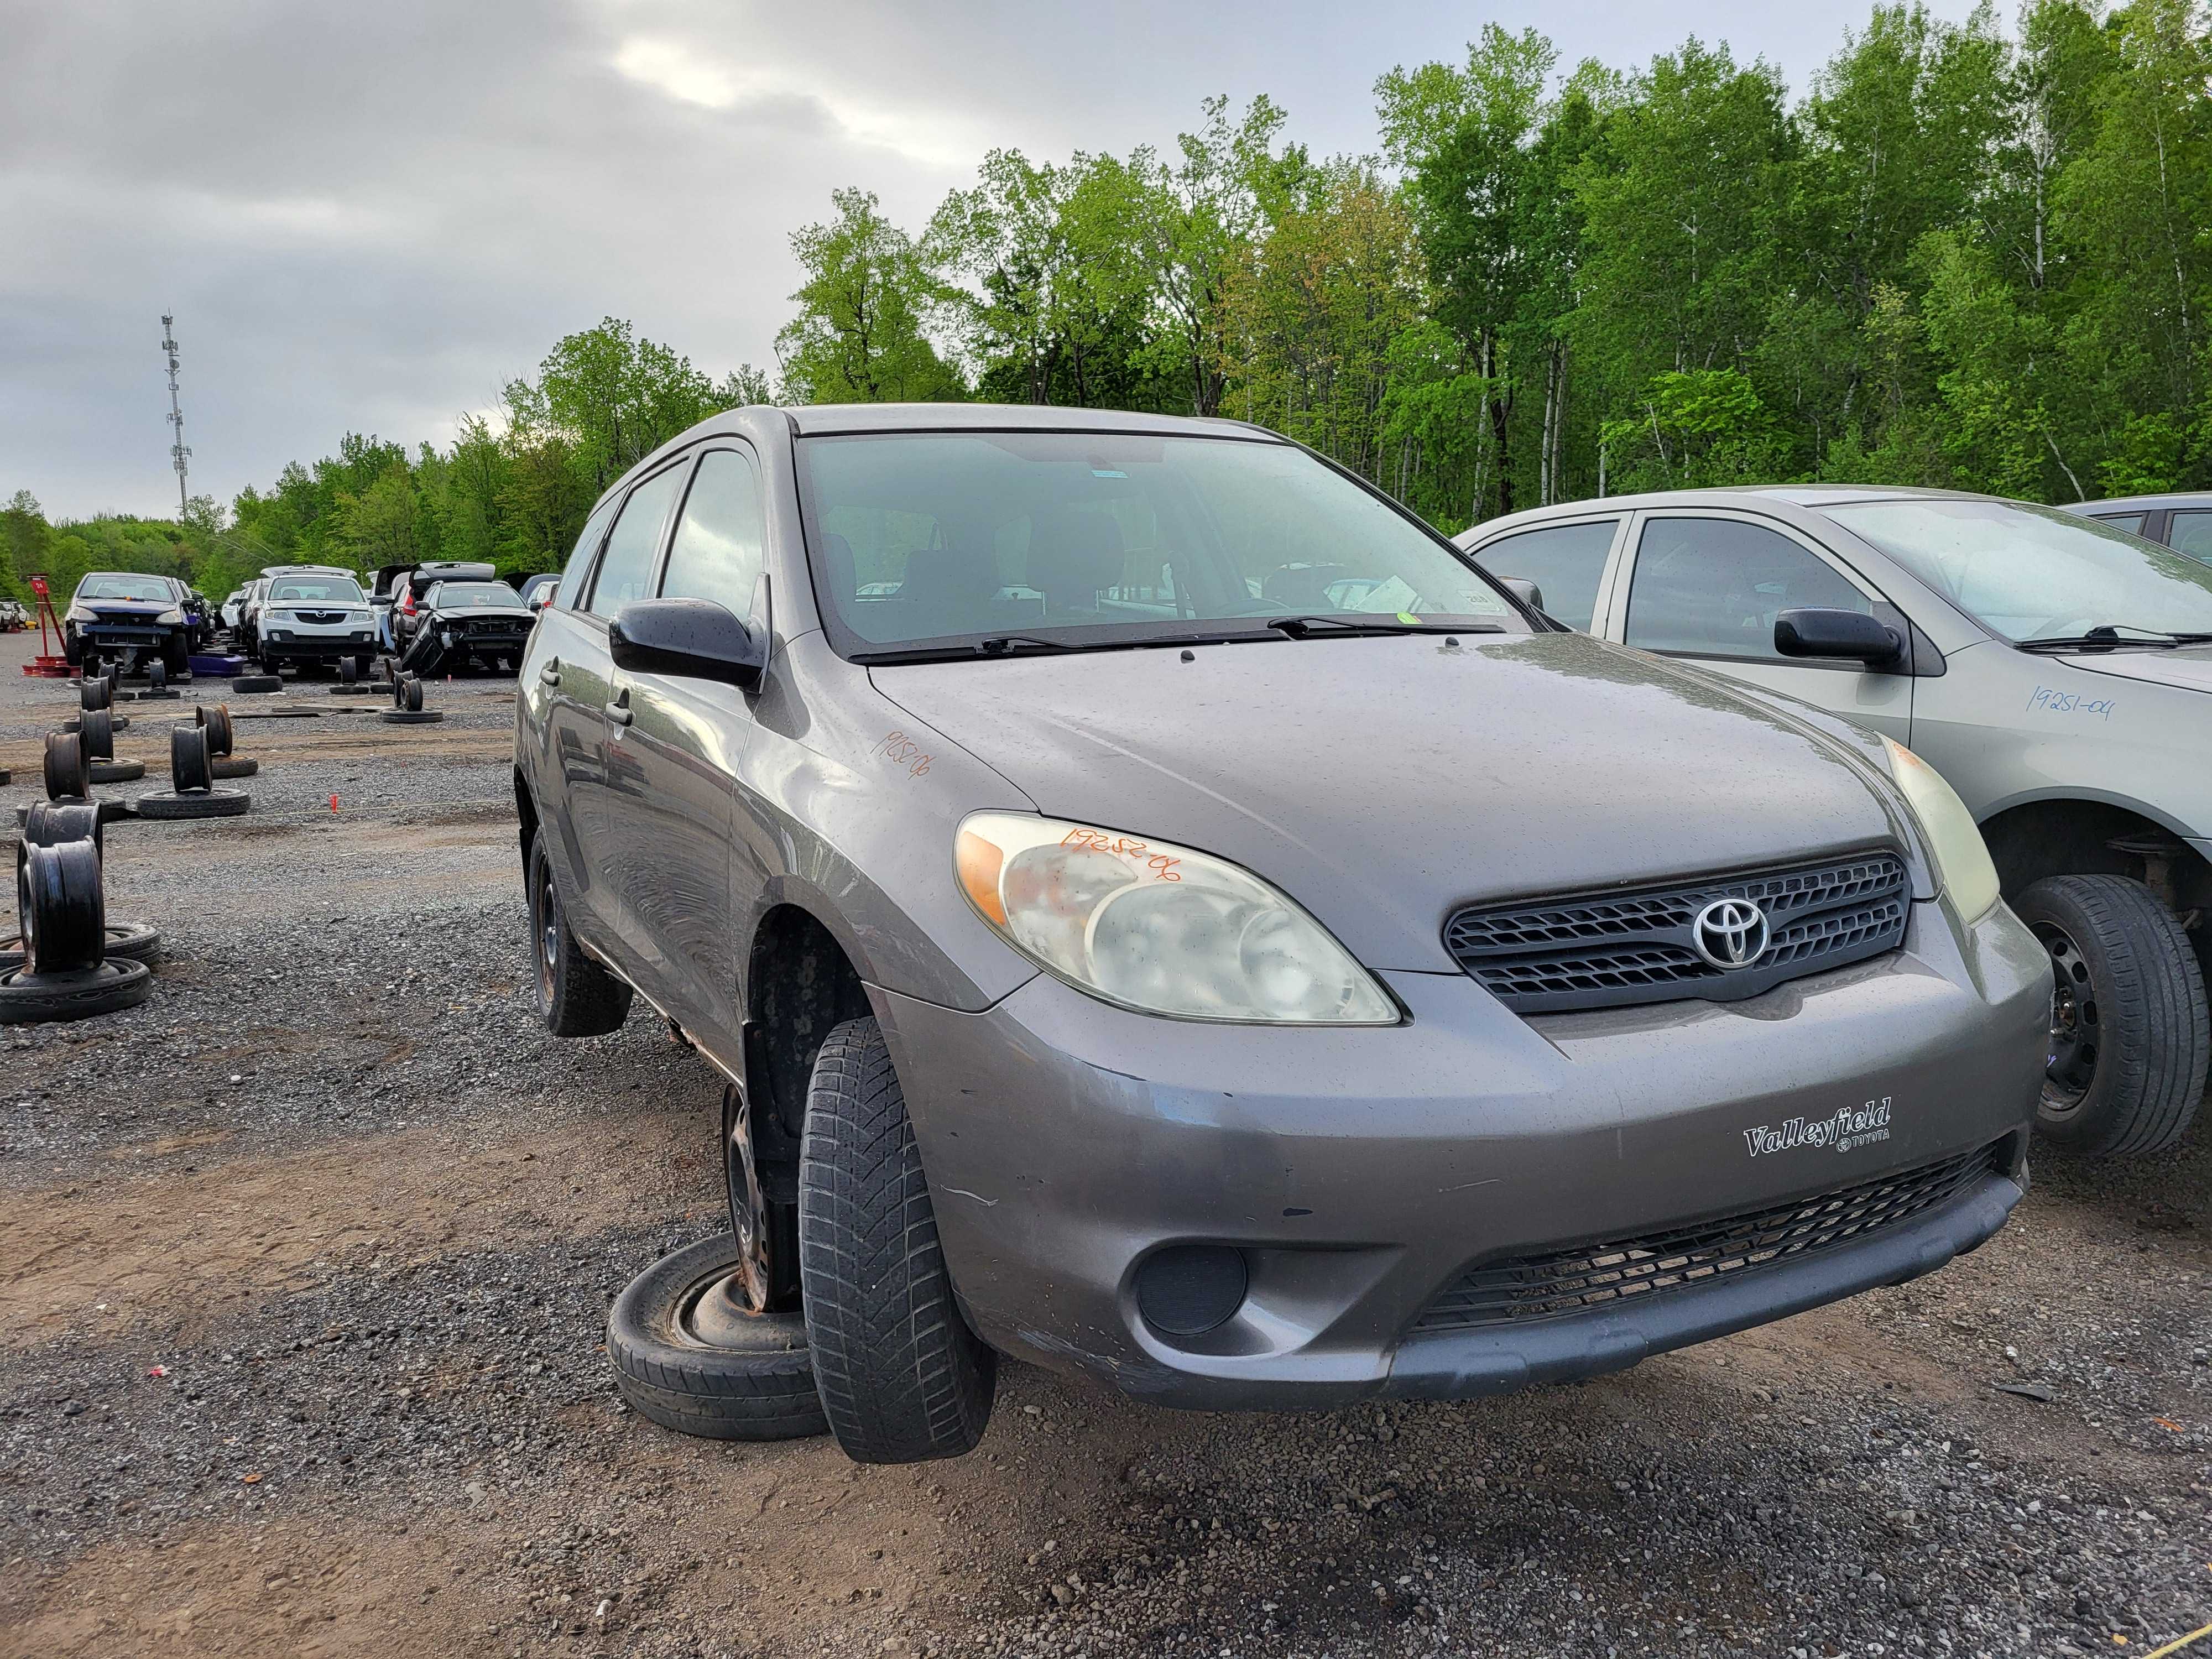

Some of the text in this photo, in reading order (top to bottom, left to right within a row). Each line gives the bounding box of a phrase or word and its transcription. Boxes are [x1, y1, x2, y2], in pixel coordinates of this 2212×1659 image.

[2026, 685, 2116, 722] 19251-04
[1060, 828, 1181, 881] 19252-06
[1743, 1096, 1892, 1157] Valleyfield
[1852, 1128, 1890, 1148] TOYOTA
